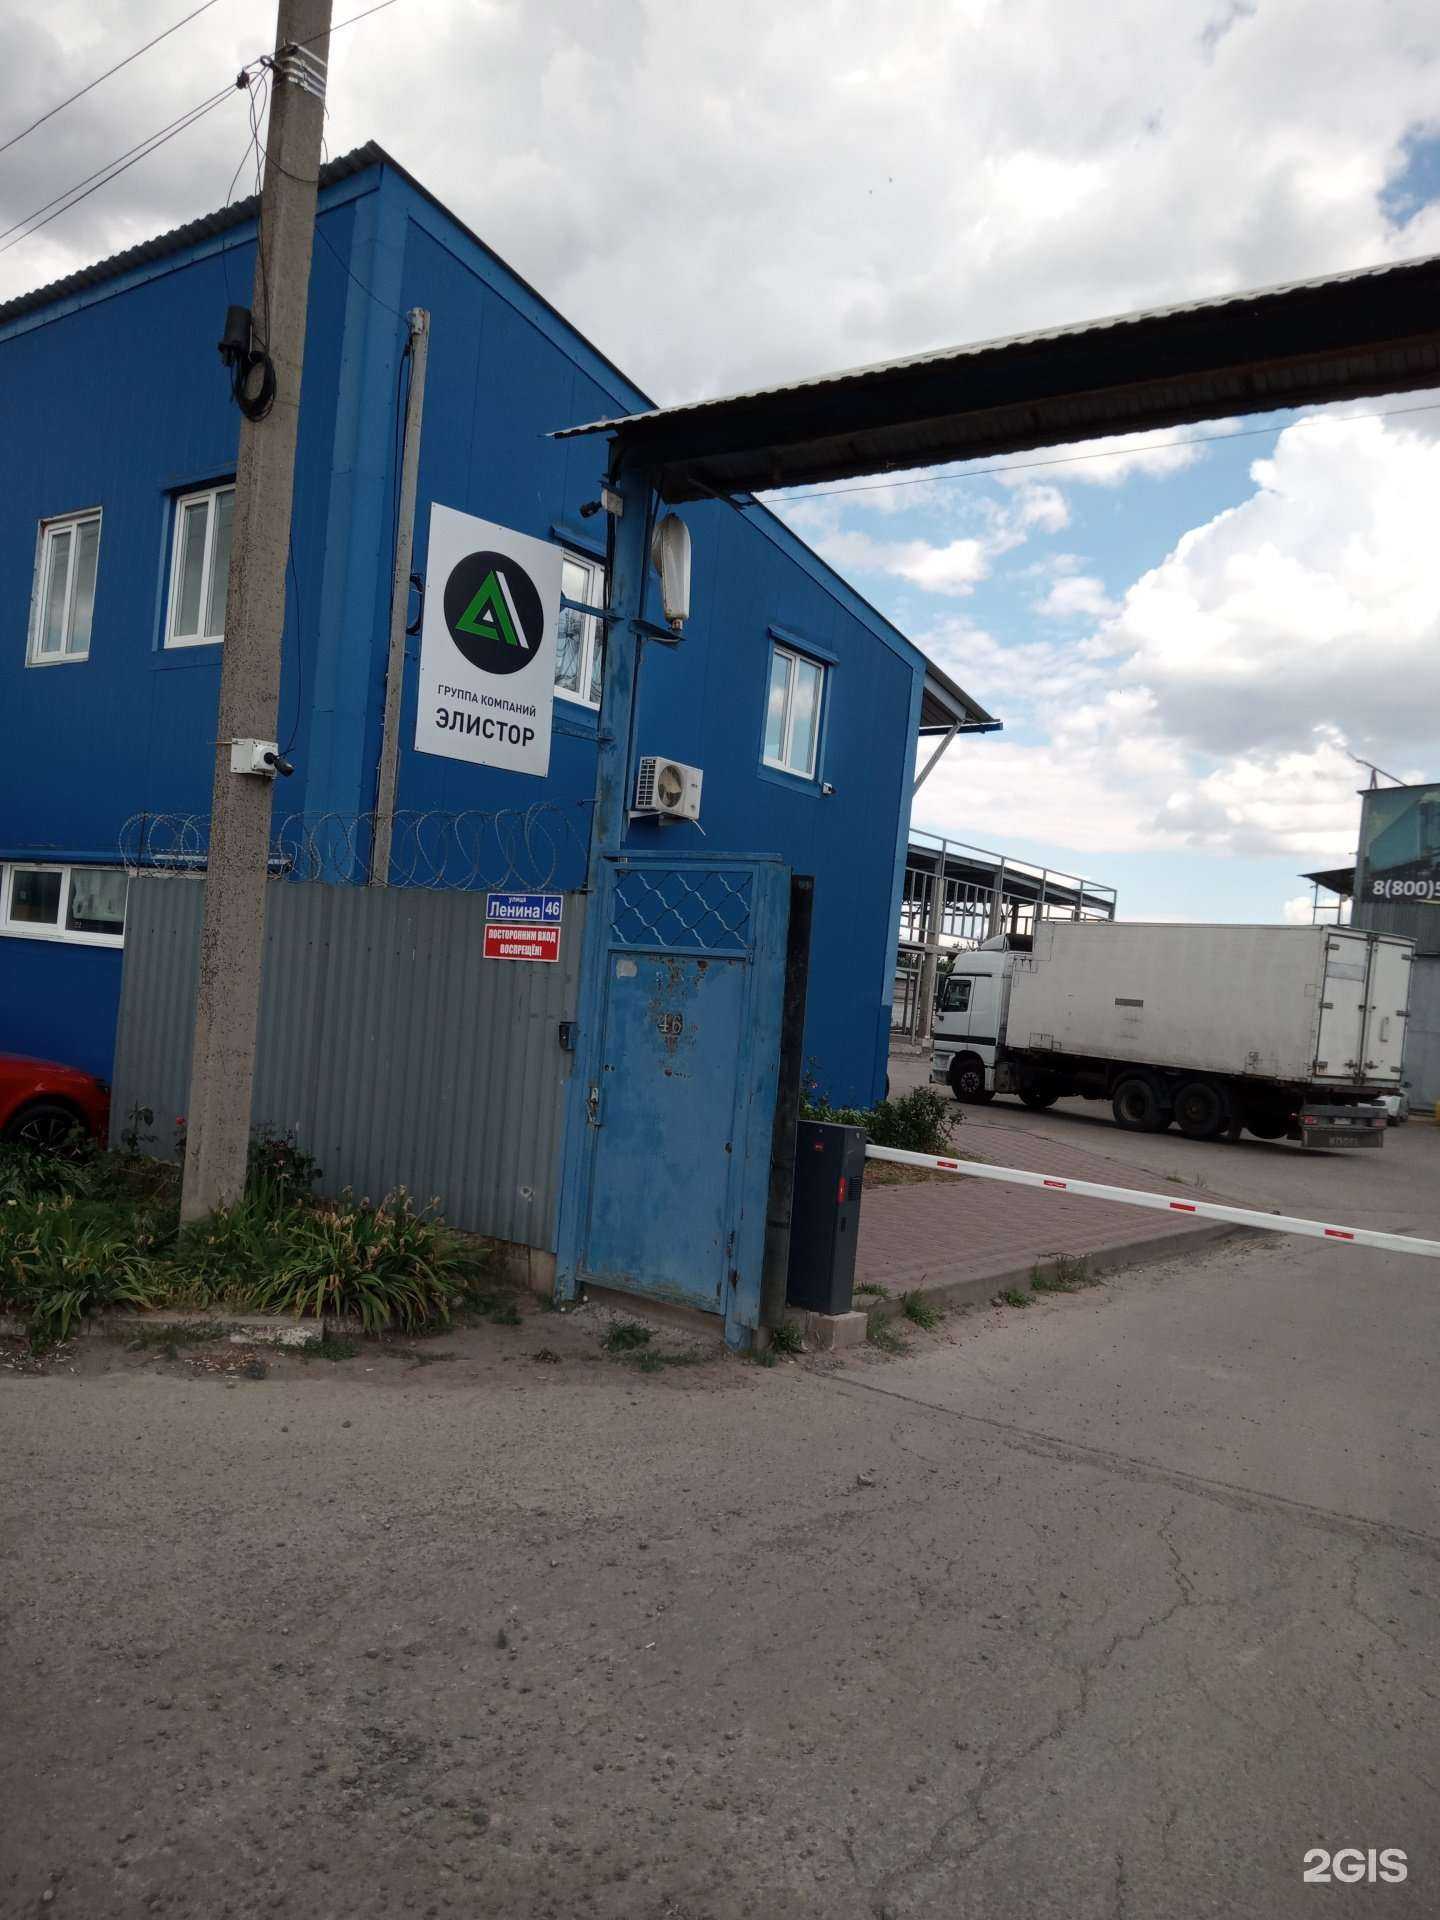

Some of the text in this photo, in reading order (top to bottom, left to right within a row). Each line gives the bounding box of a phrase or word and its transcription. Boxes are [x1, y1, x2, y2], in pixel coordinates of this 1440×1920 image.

[437, 684, 537, 717] ГРУППА КОМПАНИЙ
[435, 707, 535, 747] ЭЛИСТОР
[489, 901, 560, 918] Ленина 46
[488, 928, 557, 944] ПОСТОРОННИМ ВХОД
[656, 1014, 682, 1034] 46
